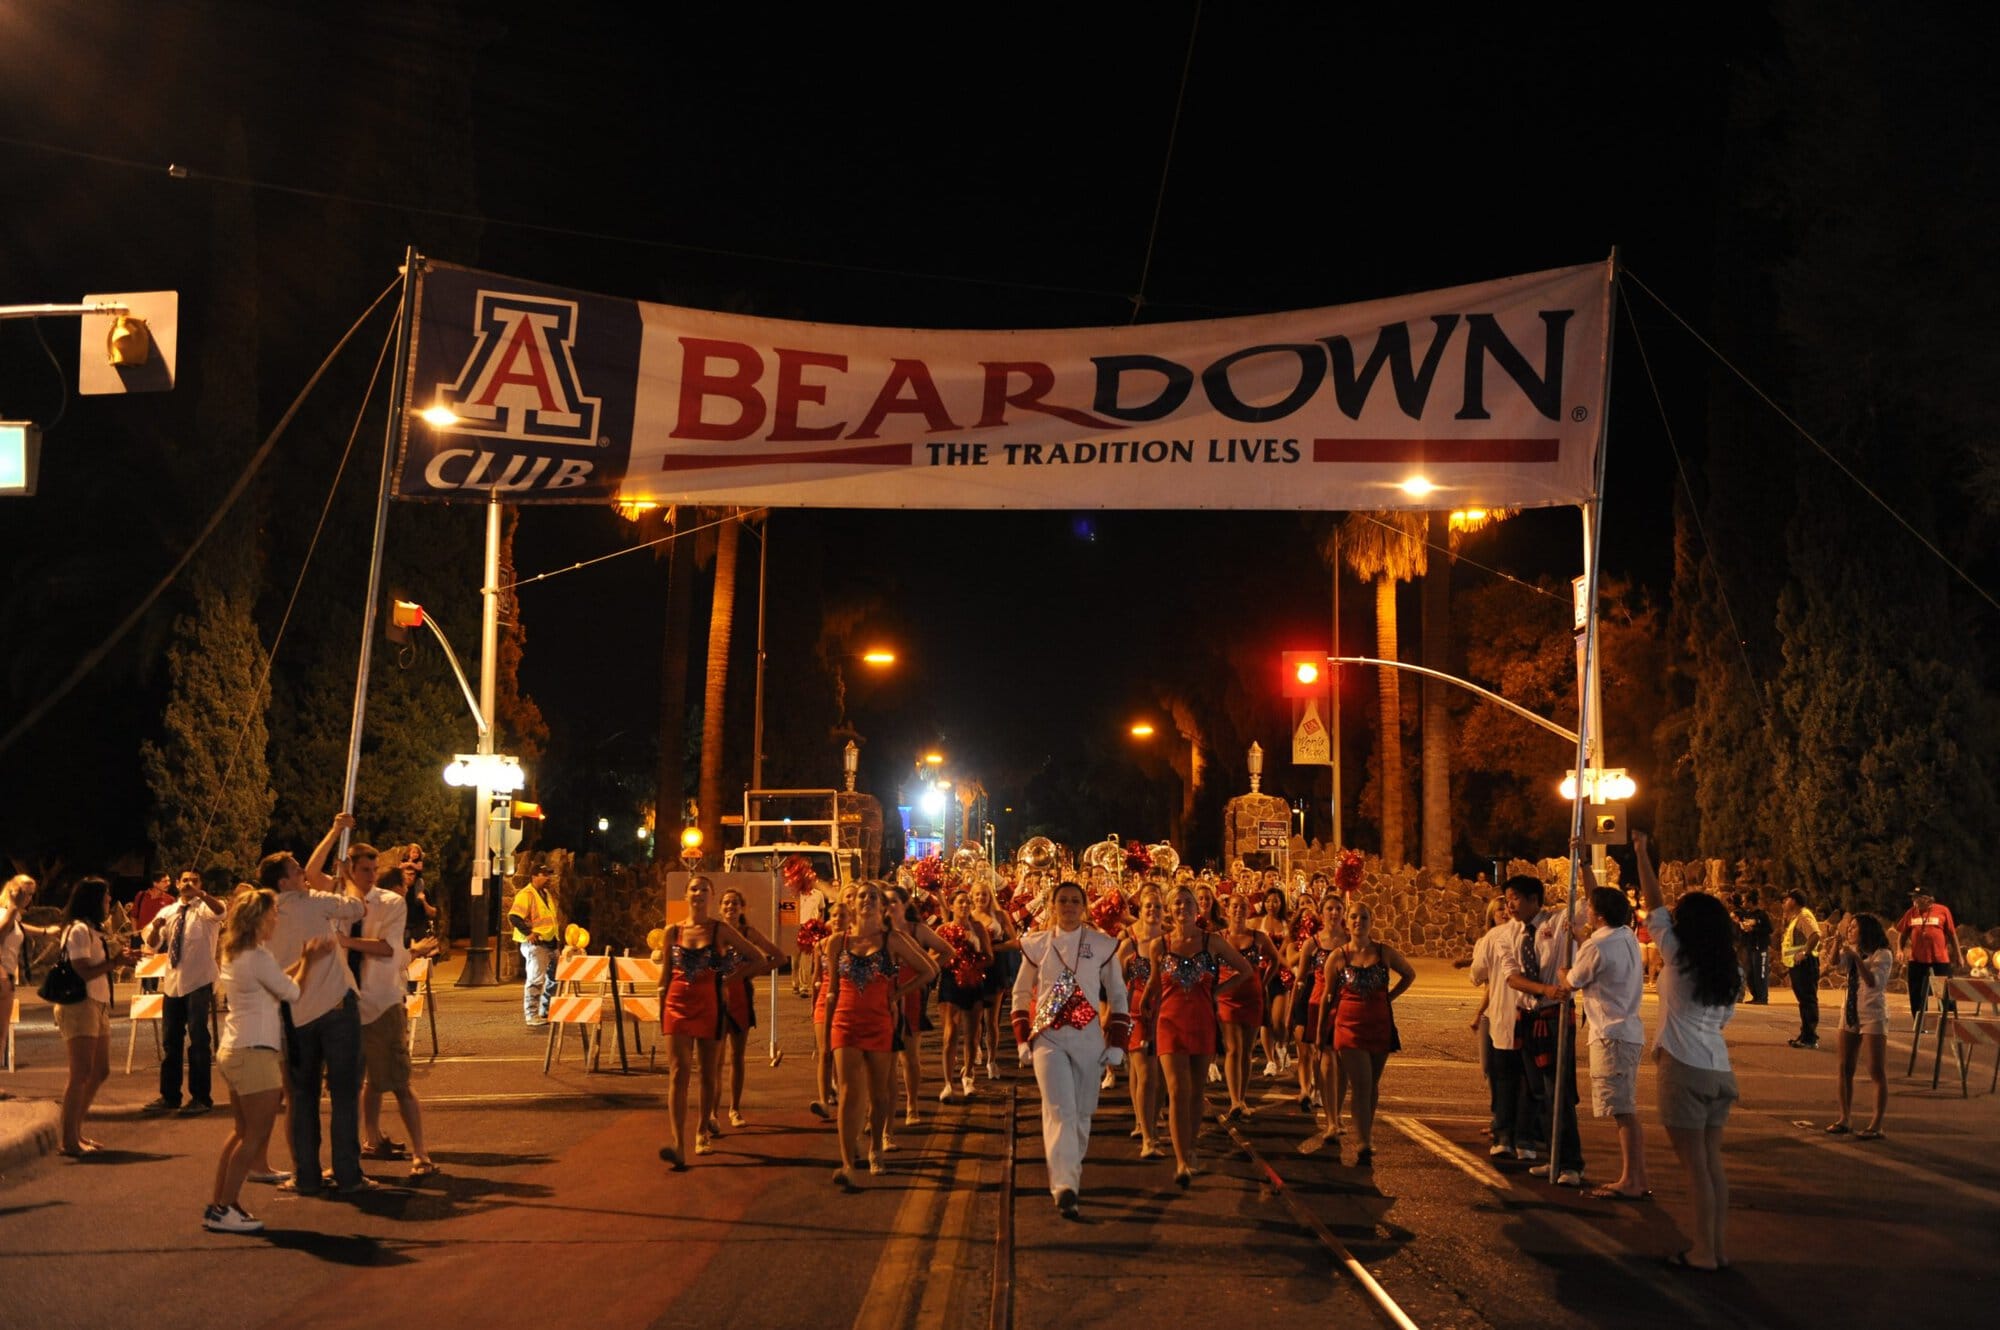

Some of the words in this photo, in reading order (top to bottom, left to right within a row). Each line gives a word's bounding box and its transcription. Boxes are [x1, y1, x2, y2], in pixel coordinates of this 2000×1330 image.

[424, 448, 594, 492] CLUB
[927, 442, 989, 466] THE
[1003, 439, 1195, 466] TRADITION
[1207, 438, 1301, 464] LIVES
